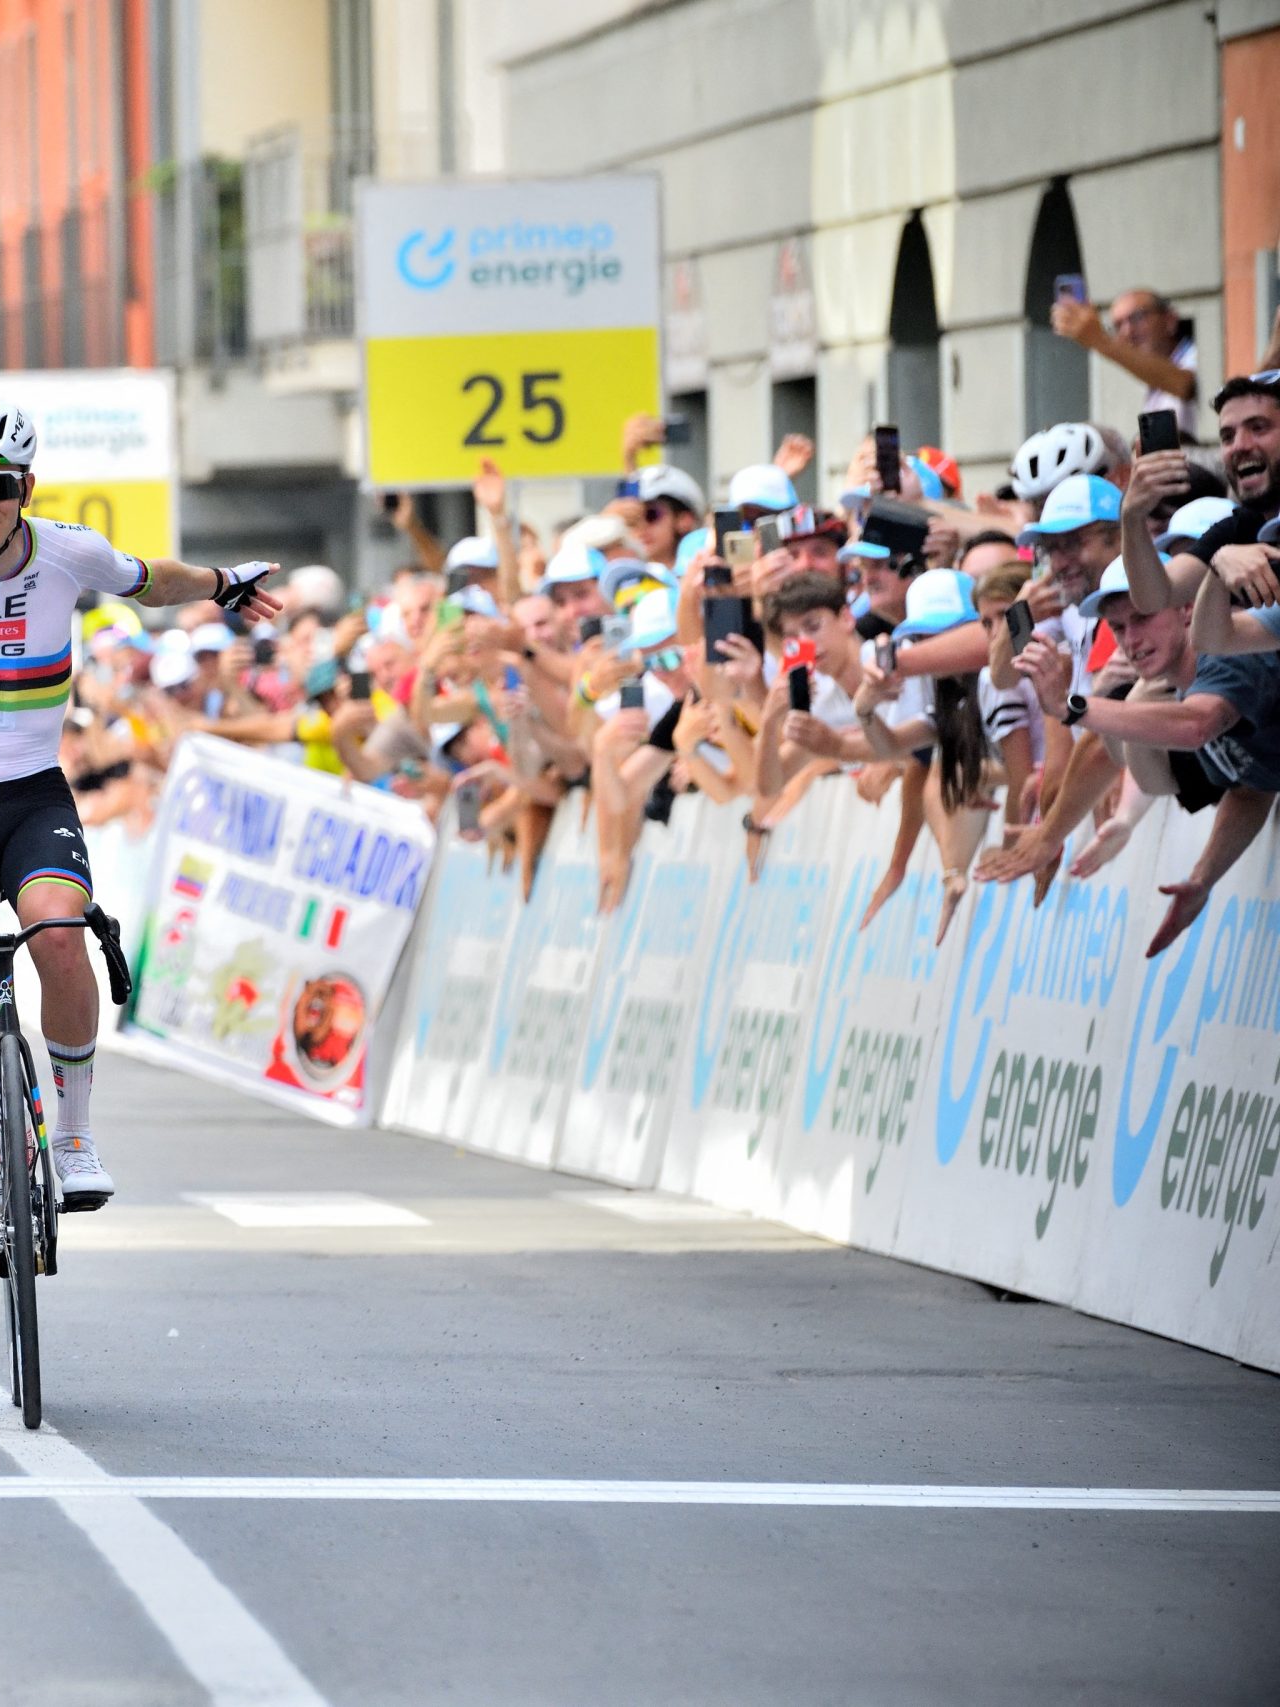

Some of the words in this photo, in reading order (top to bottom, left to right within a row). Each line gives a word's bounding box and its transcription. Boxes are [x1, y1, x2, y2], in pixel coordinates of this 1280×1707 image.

[470, 219, 614, 256] primeo
[471, 249, 622, 297] energie
[462, 371, 565, 447] 25
[1001, 834, 1128, 1026] primeo
[830, 990, 923, 1196] energie
[979, 1017, 1102, 1240] energie
[1161, 1055, 1280, 1288] energie
